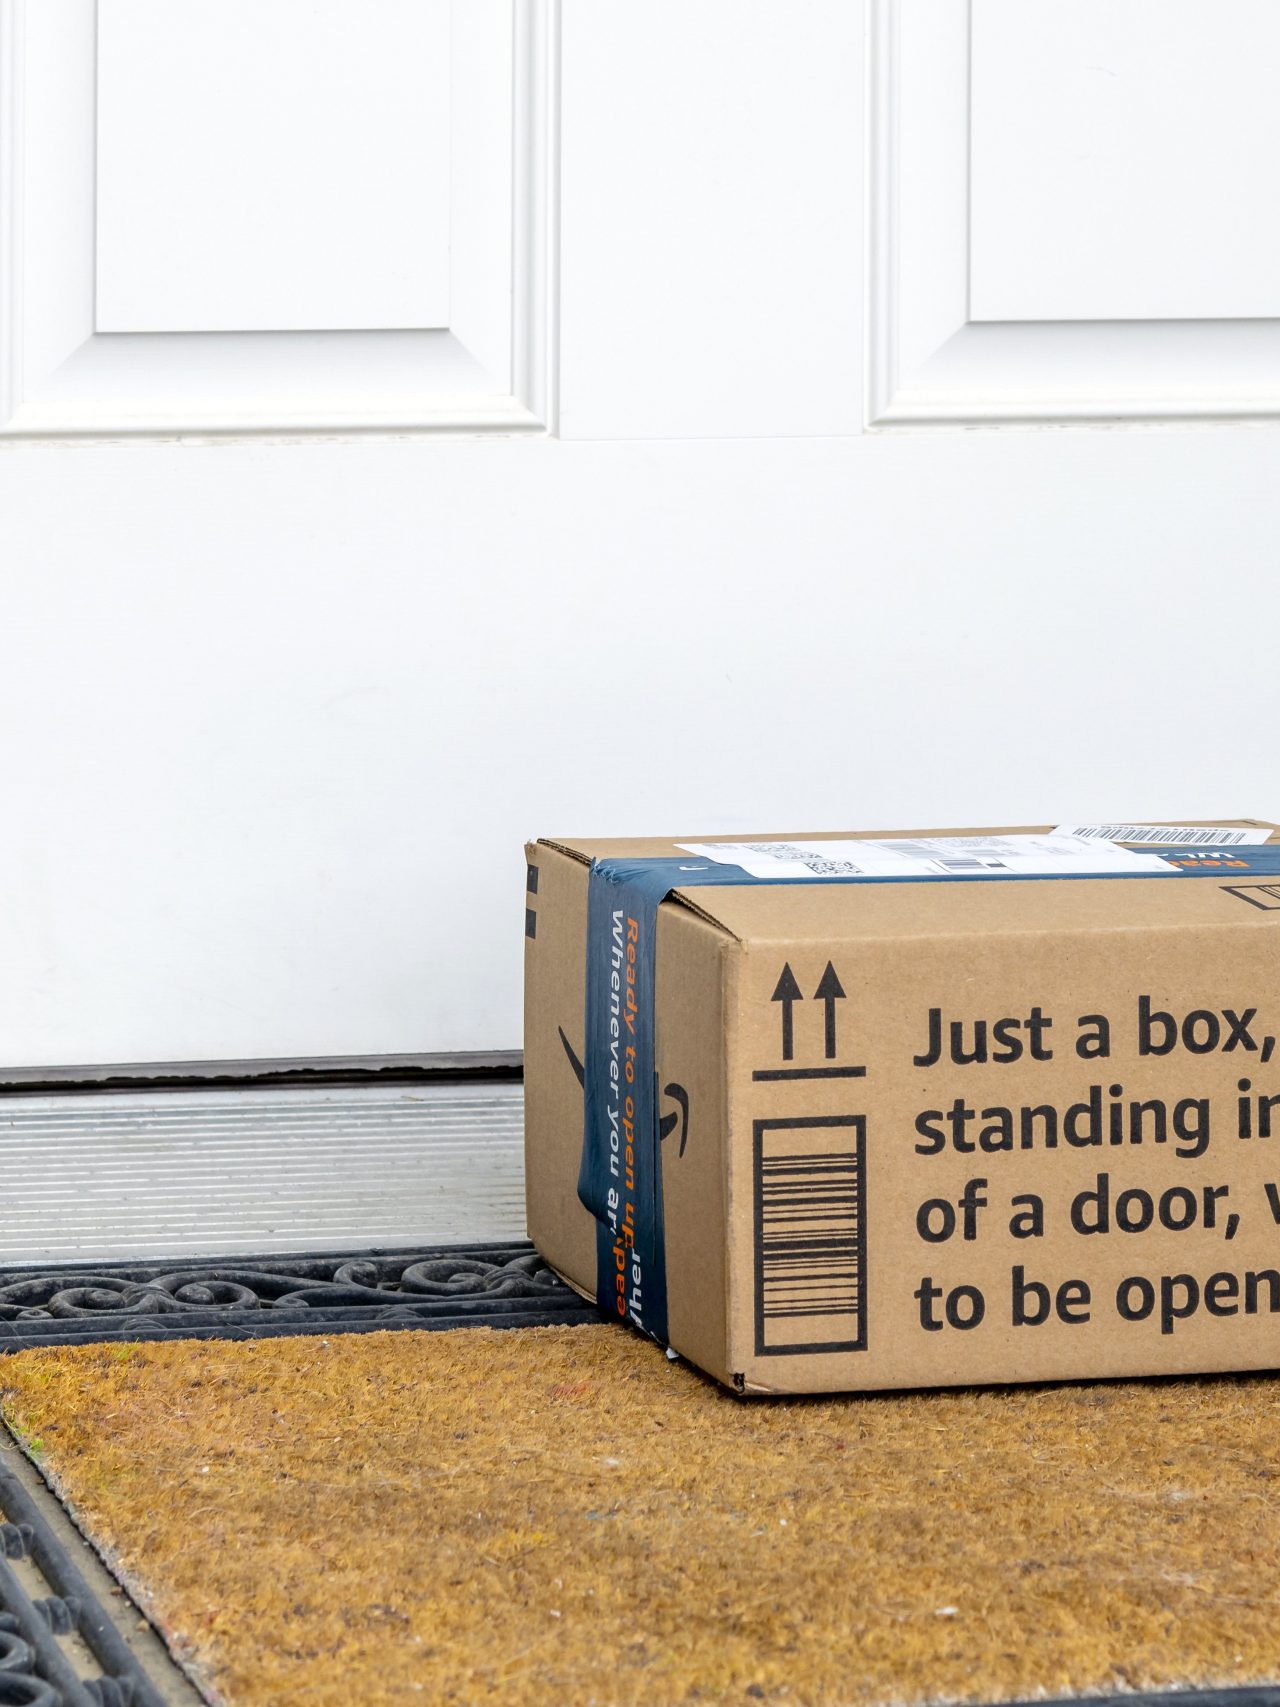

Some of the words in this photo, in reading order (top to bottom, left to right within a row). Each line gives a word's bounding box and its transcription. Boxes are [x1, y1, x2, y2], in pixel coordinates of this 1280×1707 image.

[610, 910, 624, 1100] Whenever
[624, 916, 639, 1035] Ready
[625, 1046, 637, 1084] to
[913, 1007, 1053, 1068] Just
[1075, 1014, 1111, 1060] a
[1138, 995, 1276, 1063] box,
[607, 1104, 620, 1178] you
[622, 1095, 635, 1191] open
[914, 1083, 1210, 1159] standing
[607, 1187, 619, 1236] ar
[916, 1178, 988, 1243] of
[1008, 1194, 1044, 1239] a
[1070, 1172, 1241, 1240] door,
[913, 1277, 986, 1332] to
[1011, 1265, 1091, 1327] be
